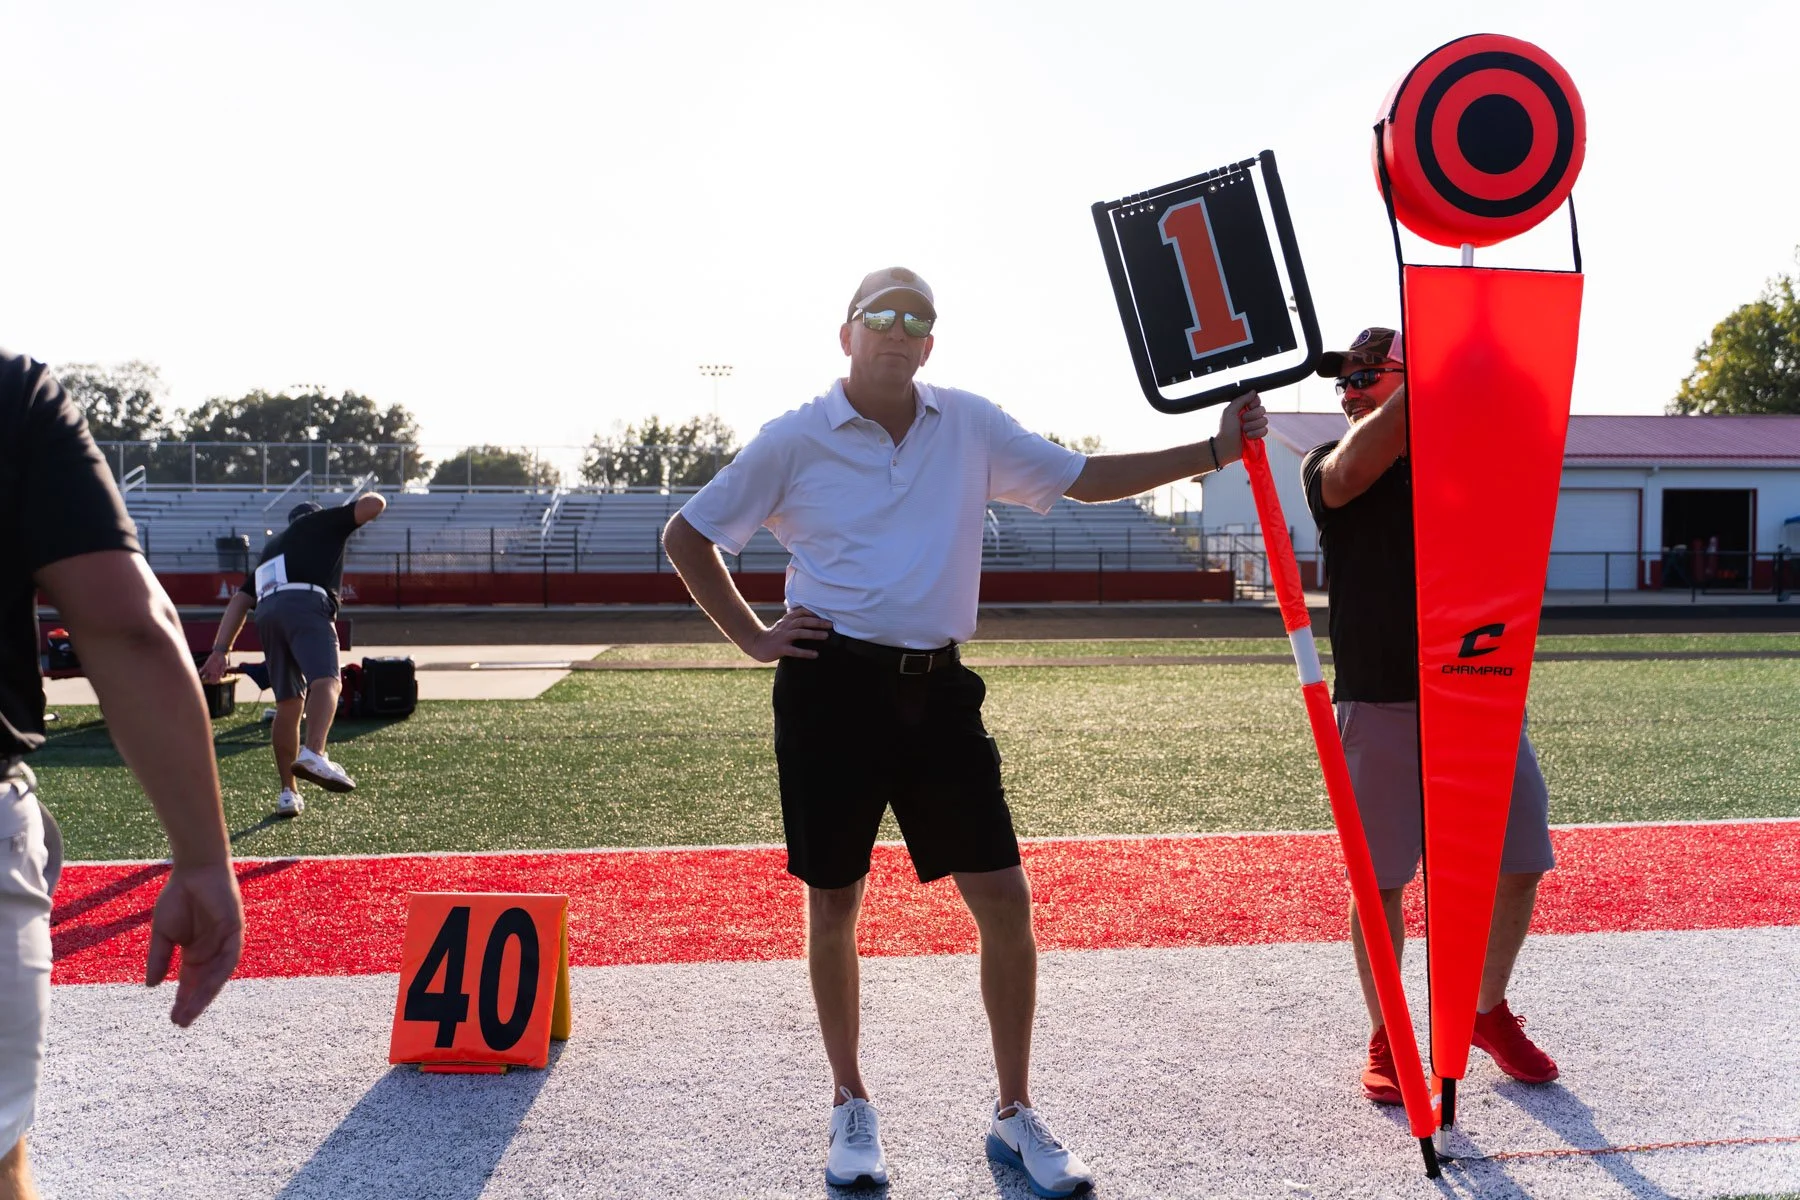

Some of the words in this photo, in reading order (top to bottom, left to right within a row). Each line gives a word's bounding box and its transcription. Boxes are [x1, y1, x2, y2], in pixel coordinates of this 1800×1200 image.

[1157, 196, 1254, 361] 1
[1441, 664, 1514, 677] CHAMPRO
[403, 906, 540, 1052] 40
